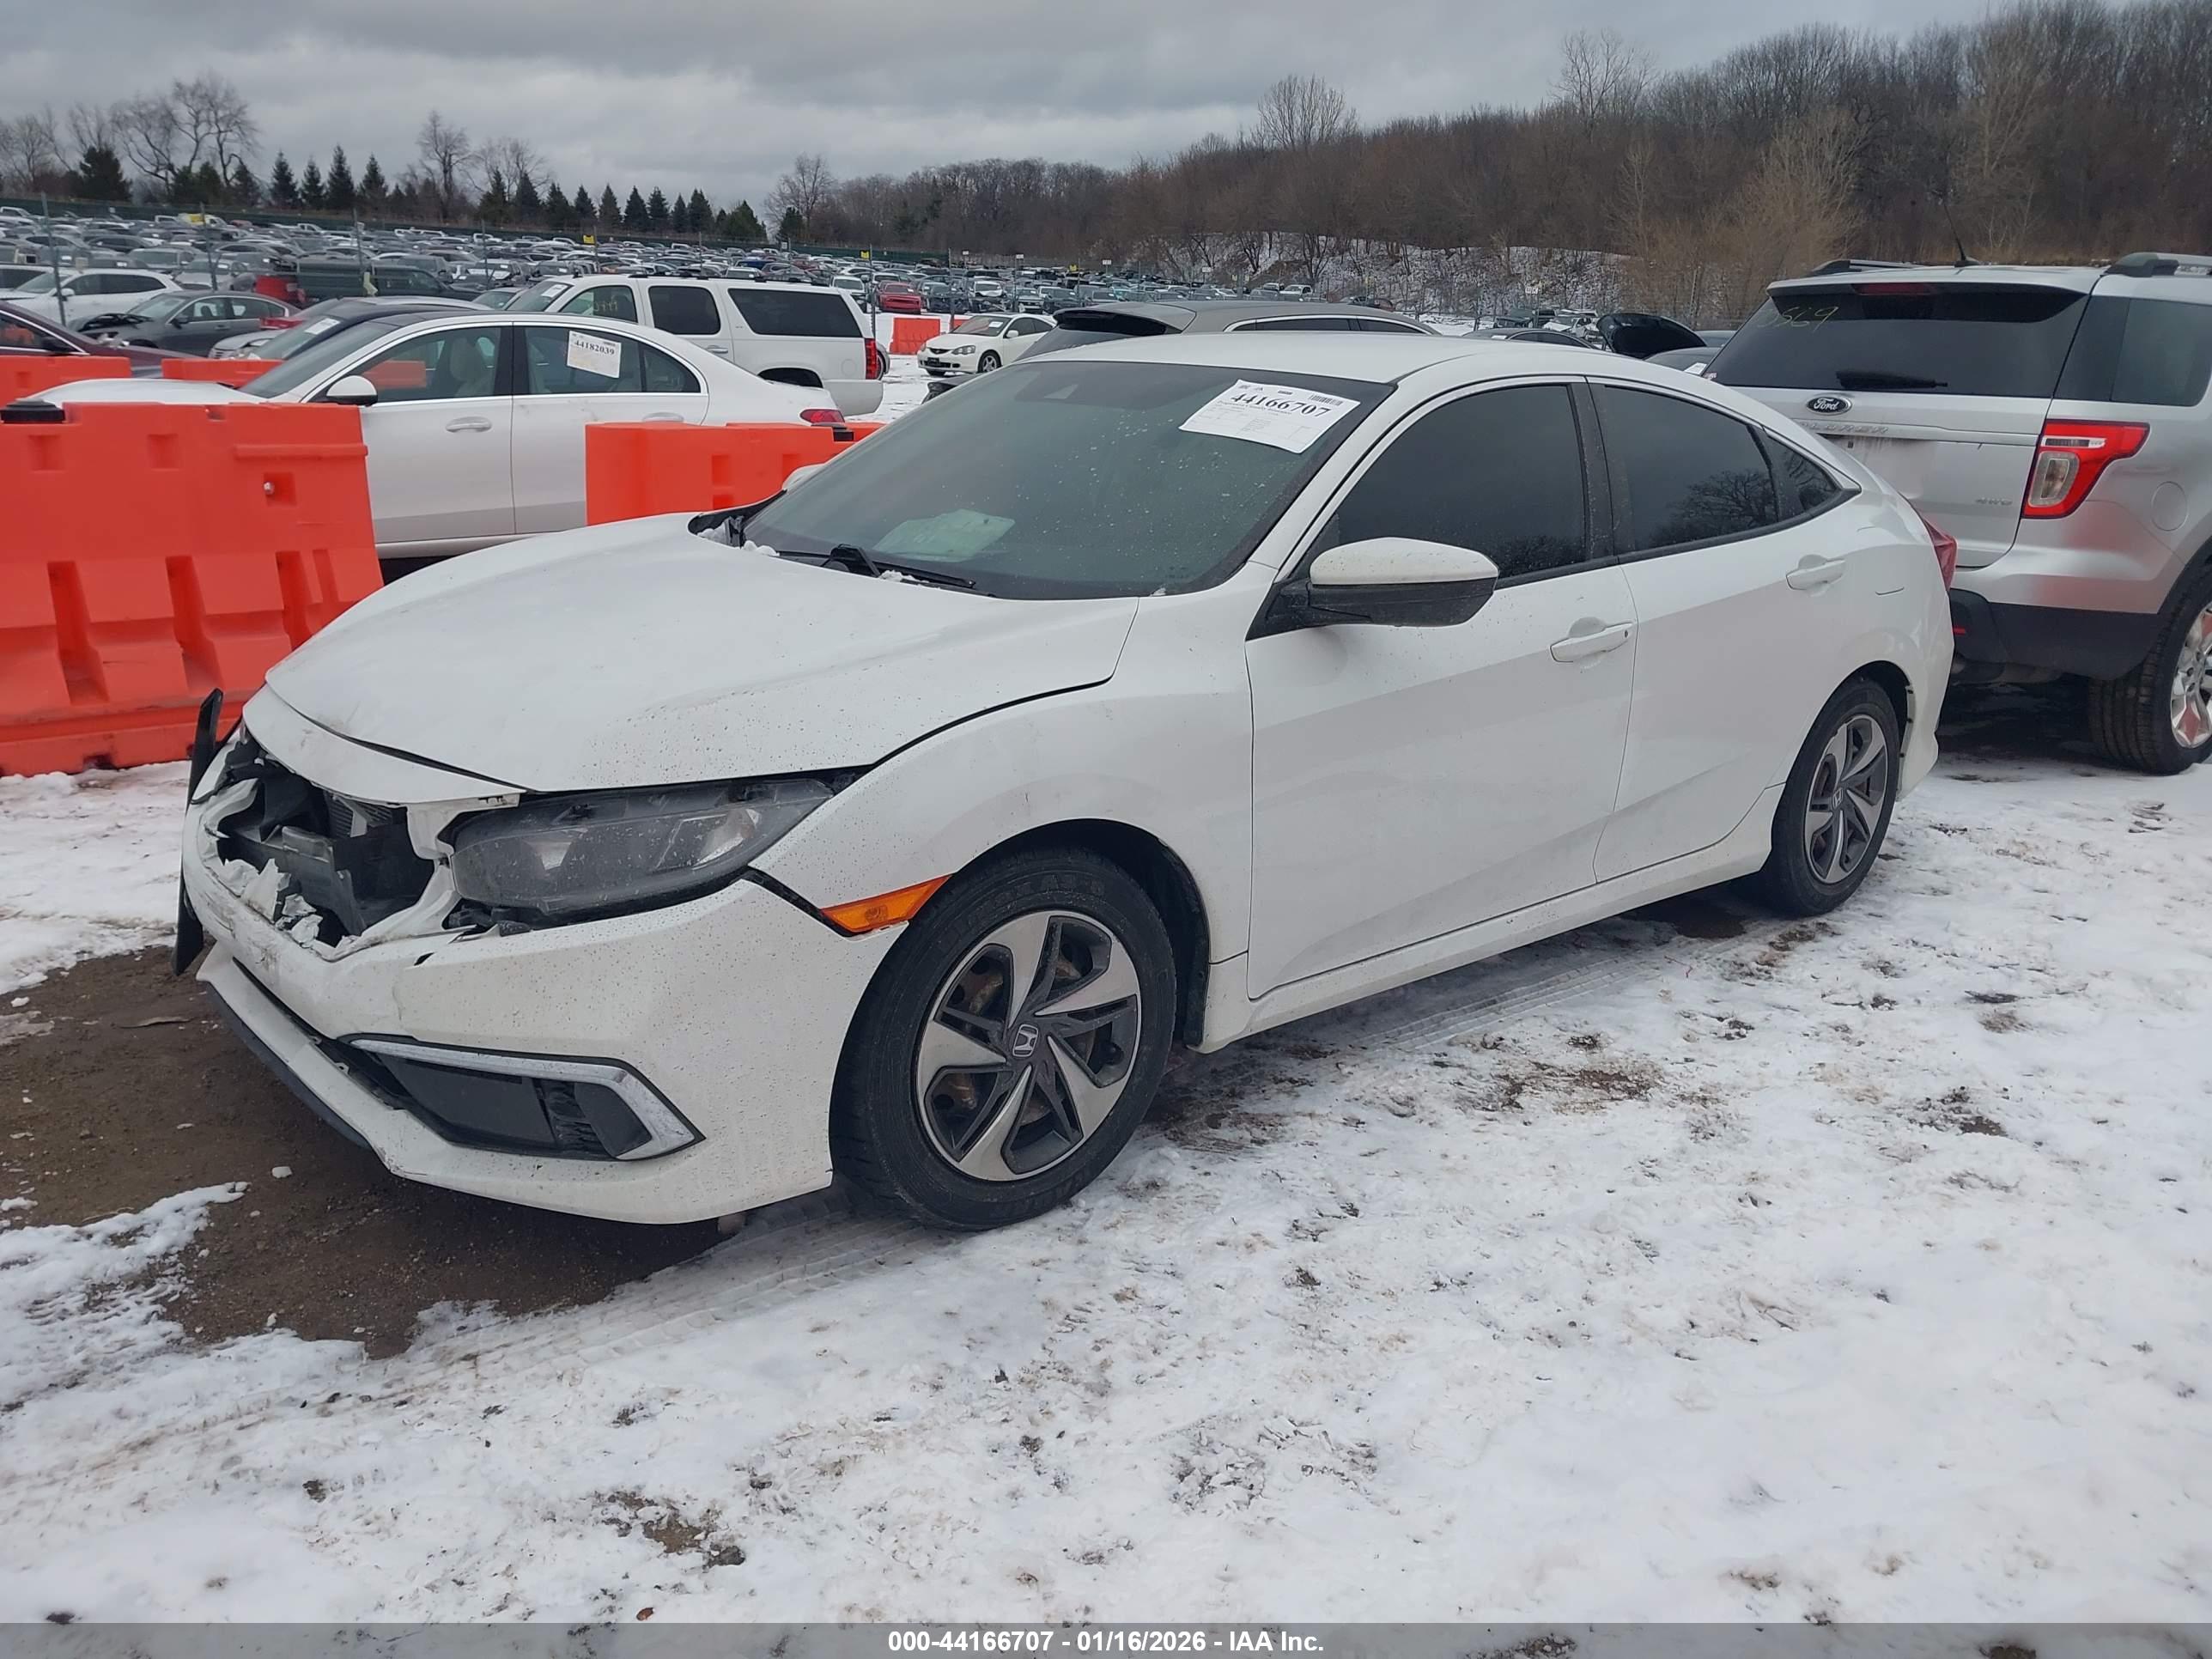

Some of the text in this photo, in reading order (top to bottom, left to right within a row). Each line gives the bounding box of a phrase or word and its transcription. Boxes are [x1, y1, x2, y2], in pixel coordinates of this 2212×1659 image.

[574, 339, 615, 355] 44182039
[1231, 392, 1331, 418] 44166707
[1813, 397, 1839, 411] Ford
